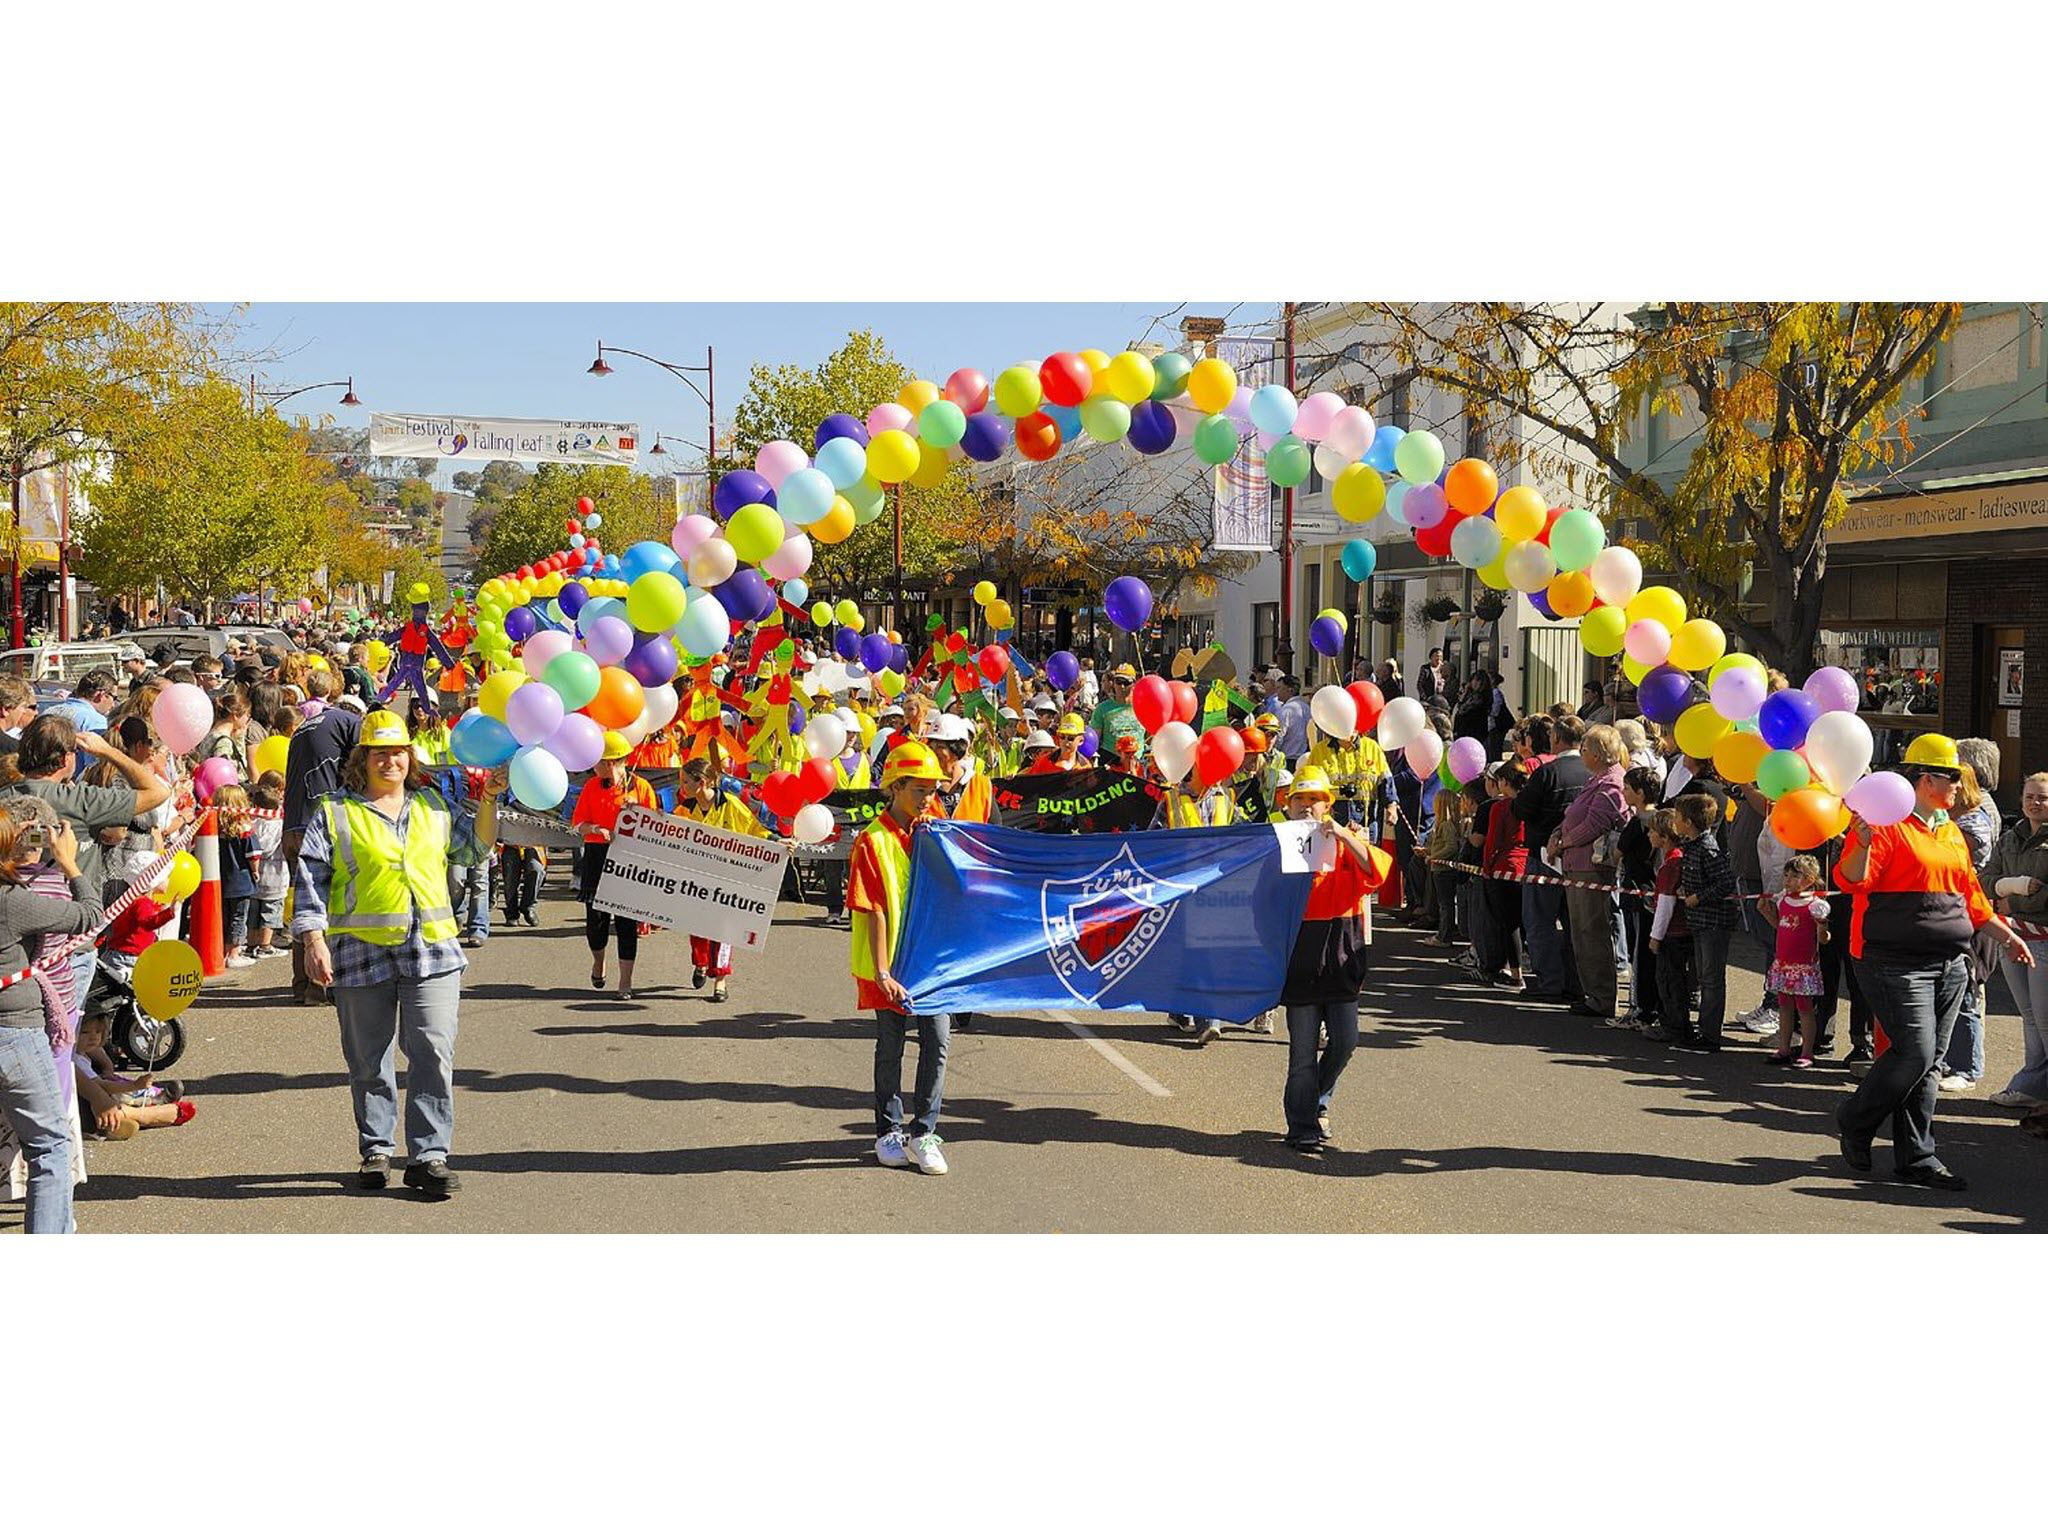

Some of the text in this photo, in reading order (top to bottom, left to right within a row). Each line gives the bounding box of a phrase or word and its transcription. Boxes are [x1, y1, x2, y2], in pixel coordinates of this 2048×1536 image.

[406, 417, 454, 436] Festival
[474, 431, 514, 457] Falling
[516, 433, 543, 452] Leaf
[1274, 521, 1320, 529] Coonwealth
[1904, 506, 1967, 526] menswear
[863, 592, 927, 601] RESAANT
[640, 814, 780, 864] Project Coordination
[1297, 836, 1313, 854] 31
[603, 859, 766, 915] Building the future
[1082, 869, 1156, 901] TUMUT
[1101, 902, 1171, 980] SCHOO
[170, 970, 200, 985] dick
